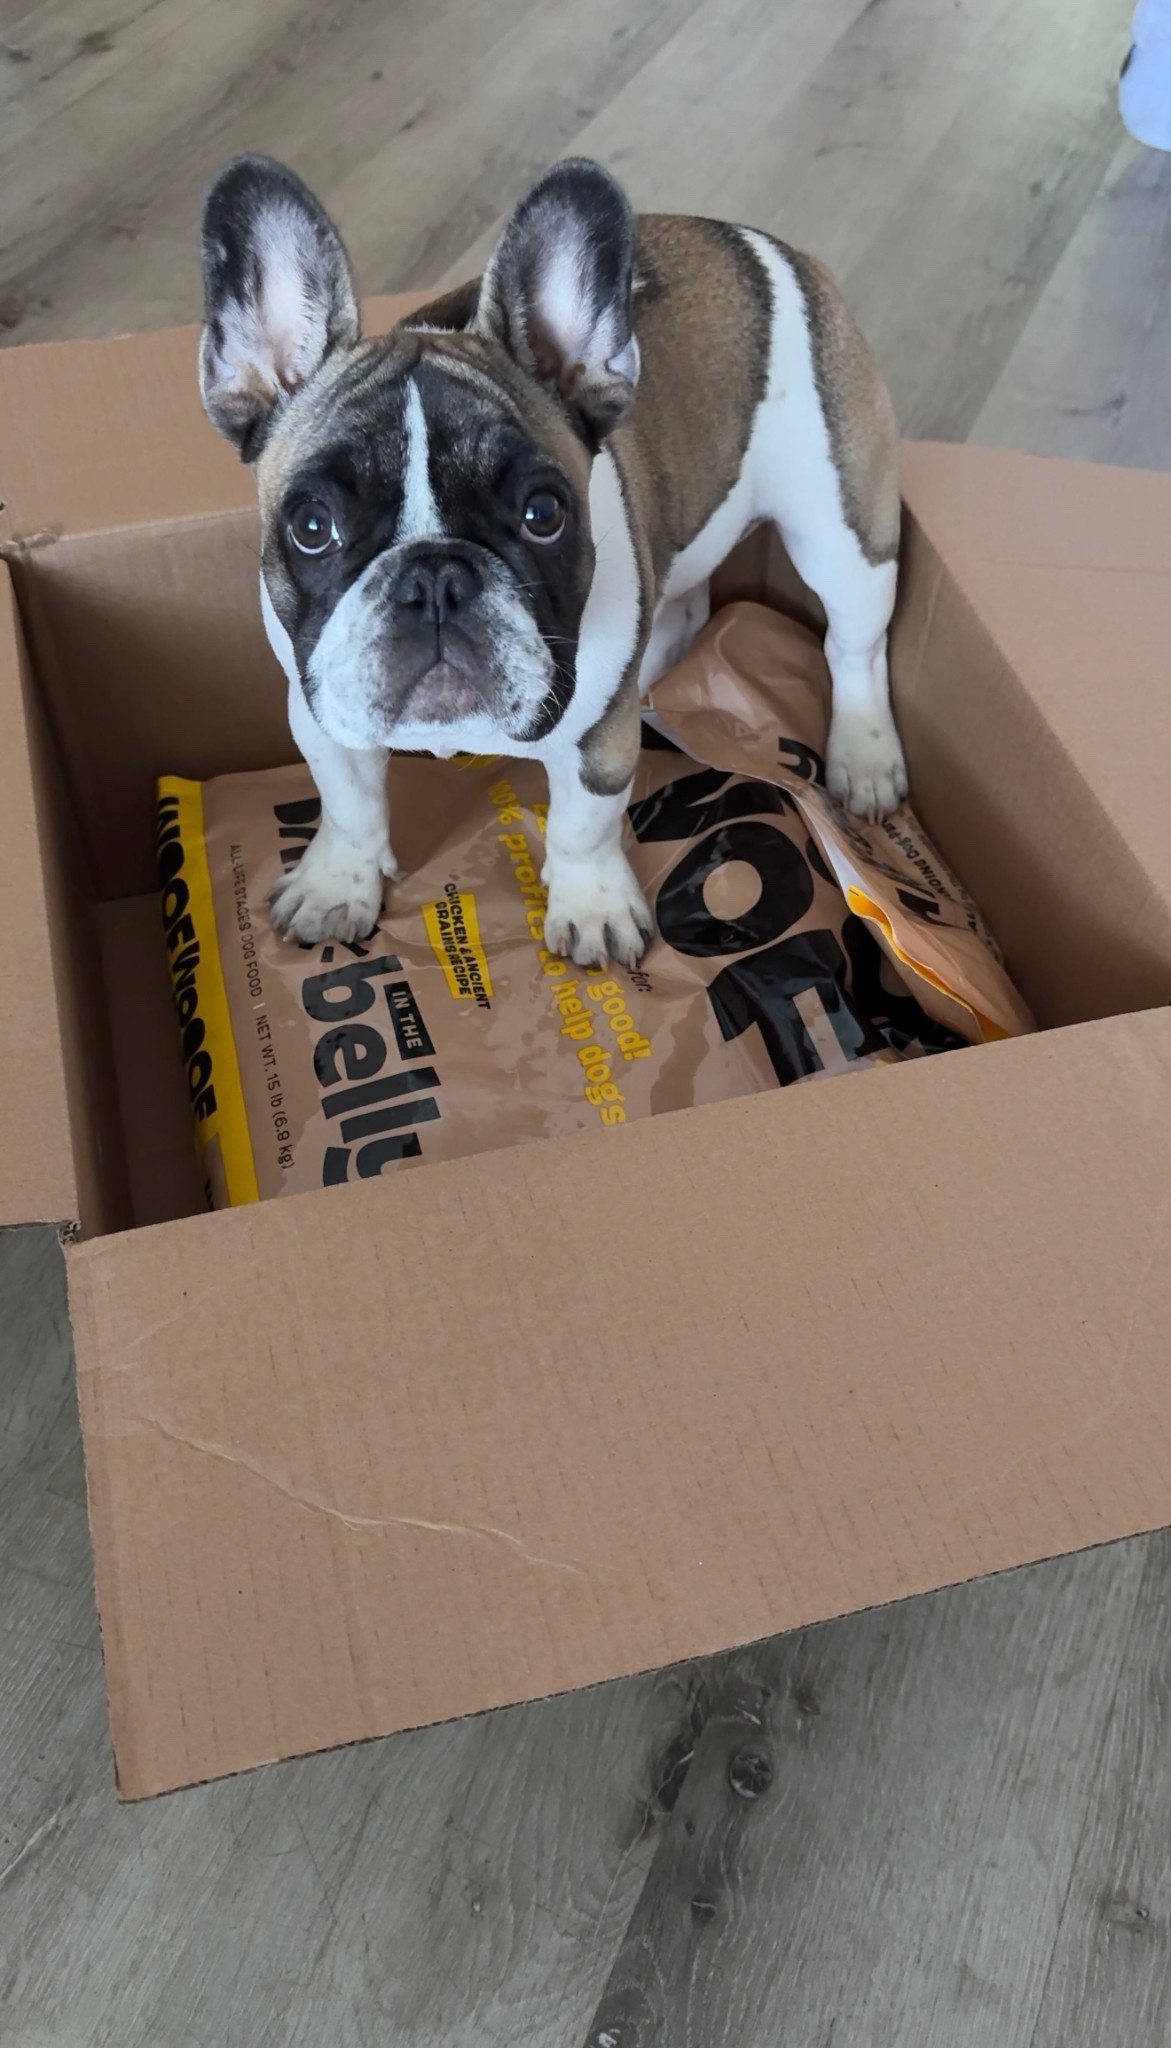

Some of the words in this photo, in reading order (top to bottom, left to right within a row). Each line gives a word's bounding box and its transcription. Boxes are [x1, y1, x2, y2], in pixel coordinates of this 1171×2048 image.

[230, 844, 247, 888] ALL-LIFE
[234, 886, 251, 932] STAGES
[241, 933, 256, 960] DOG
[435, 901, 457, 953] GRAINS
[448, 953, 472, 996] RECIPE
[444, 883, 468, 945] CHICKEN
[463, 955, 491, 1010] ANCIENT
[246, 960, 263, 998] FOOD
[392, 989, 408, 1012] IN
[255, 1014, 271, 1041] NET
[399, 1015, 423, 1049] THE
[586, 979, 653, 1062] good!
[261, 1044, 277, 1072] WT.
[550, 978, 596, 1041] help
[575, 1044, 628, 1127] dogs
[266, 1072, 281, 1092] 15
[302, 954, 442, 1187] belly
[269, 1092, 285, 1109] lb
[271, 1110, 291, 1142] (6.8
[277, 1143, 296, 1170] kg)
